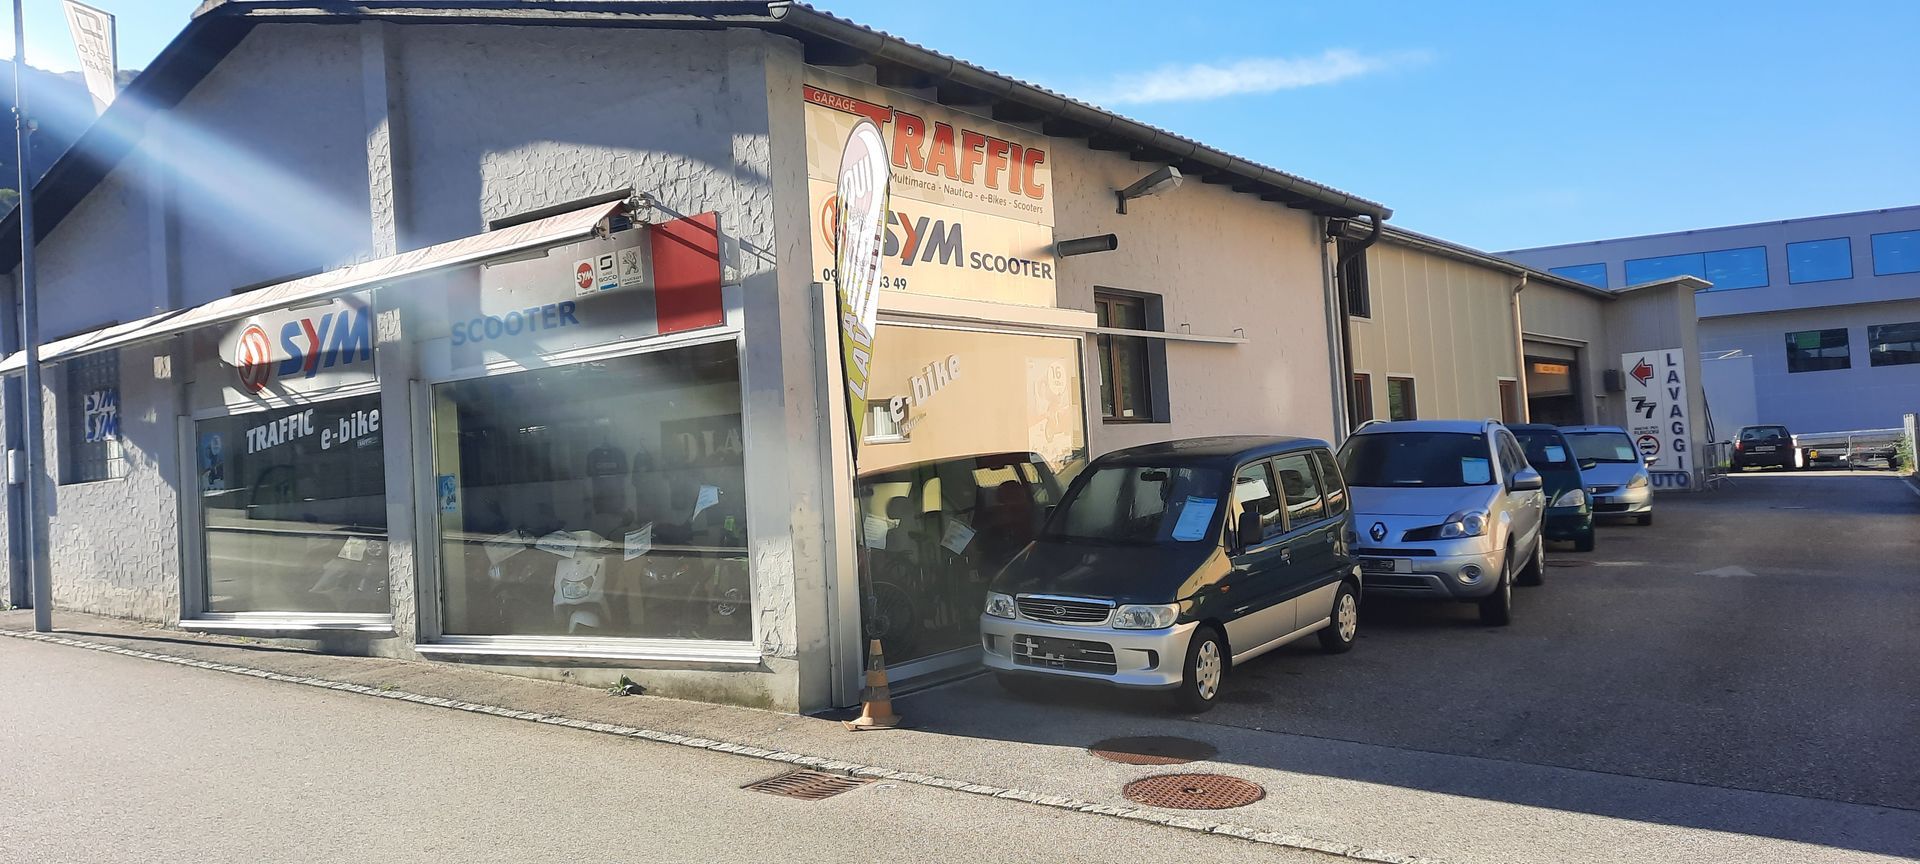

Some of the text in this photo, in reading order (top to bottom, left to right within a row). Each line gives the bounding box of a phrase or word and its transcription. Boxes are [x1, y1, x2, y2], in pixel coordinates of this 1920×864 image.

[813, 91, 856, 112] GARAGE
[890, 173, 1044, 214] Multimarca Nautica e-Bikes Scooters
[883, 210, 1053, 280] SYM SCOOTER
[576, 270, 593, 285] SYM
[893, 277, 908, 290] 49
[277, 305, 371, 379] SYM
[450, 300, 580, 347] SCOOTER
[889, 353, 962, 423] e-bike
[1631, 396, 1657, 419] 77
[246, 408, 314, 454] TRAFFIC
[321, 409, 380, 450] e-bike
[1666, 352, 1686, 470] LAVAGGI
[1650, 473, 1687, 487] UTO
